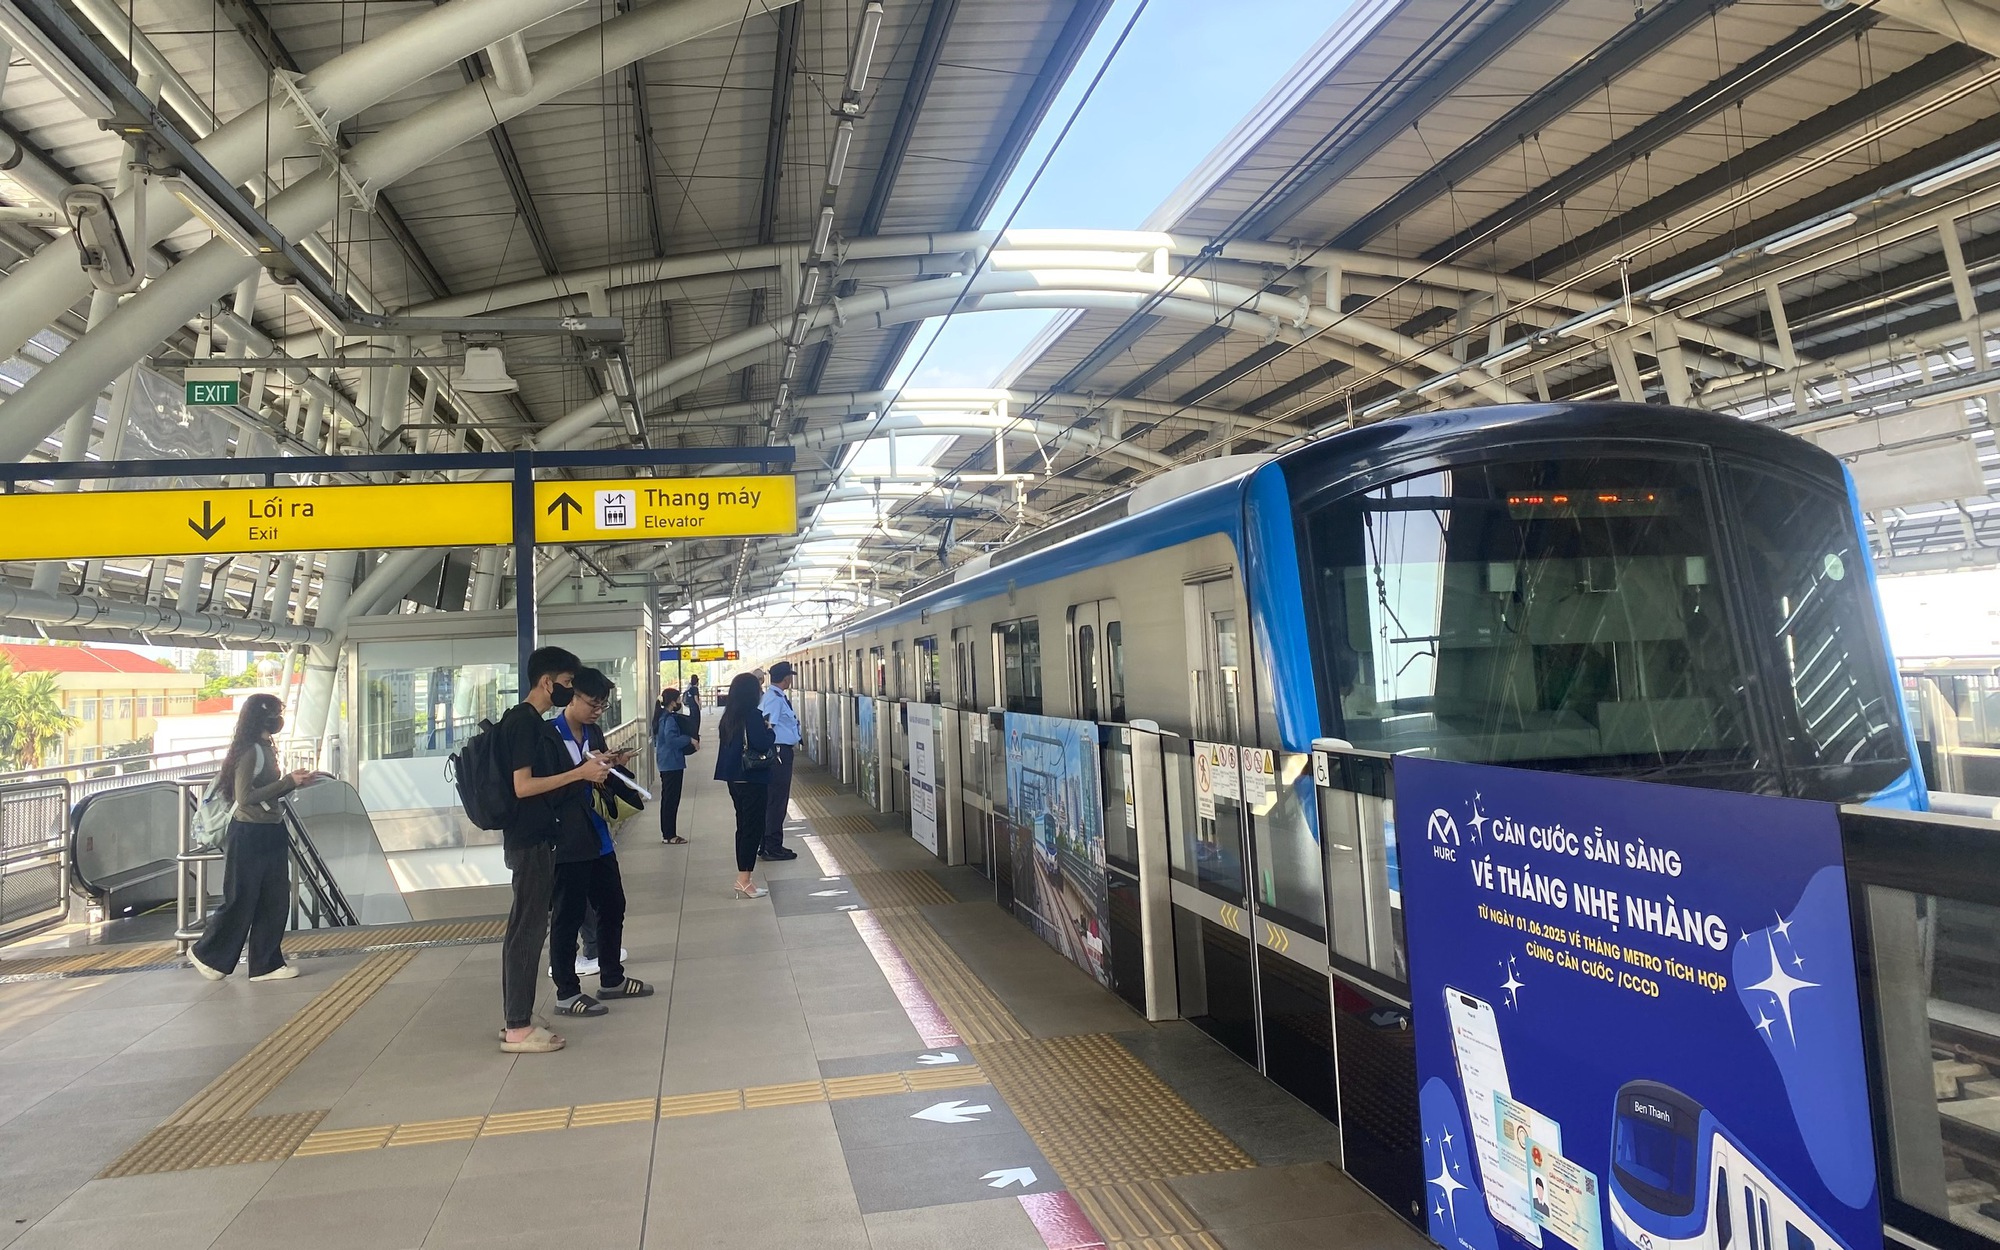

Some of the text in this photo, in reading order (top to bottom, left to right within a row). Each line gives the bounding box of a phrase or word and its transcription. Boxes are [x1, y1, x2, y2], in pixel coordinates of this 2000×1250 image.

[194, 385, 230, 402] EXIT
[249, 496, 314, 518] Lối ra
[644, 486, 761, 511] Thang máy
[644, 515, 705, 528] Elevator
[249, 526, 278, 540] Exit
[1433, 845, 1457, 862] HURC
[1492, 816, 1682, 877] CĂN CƯỚC SẴN SÀNG
[1471, 854, 1728, 951] VÉ THÁNG NHẸ NHÀNG
[1478, 903, 1727, 994] TỪ NGÀY 01.06.2025 VÉ THÁNG METRO TÍCH HỢP
[1526, 940, 1659, 998] CÙNG CĂN CƯỚC /CCCD
[1634, 1101, 1670, 1123] Ben Thanh
